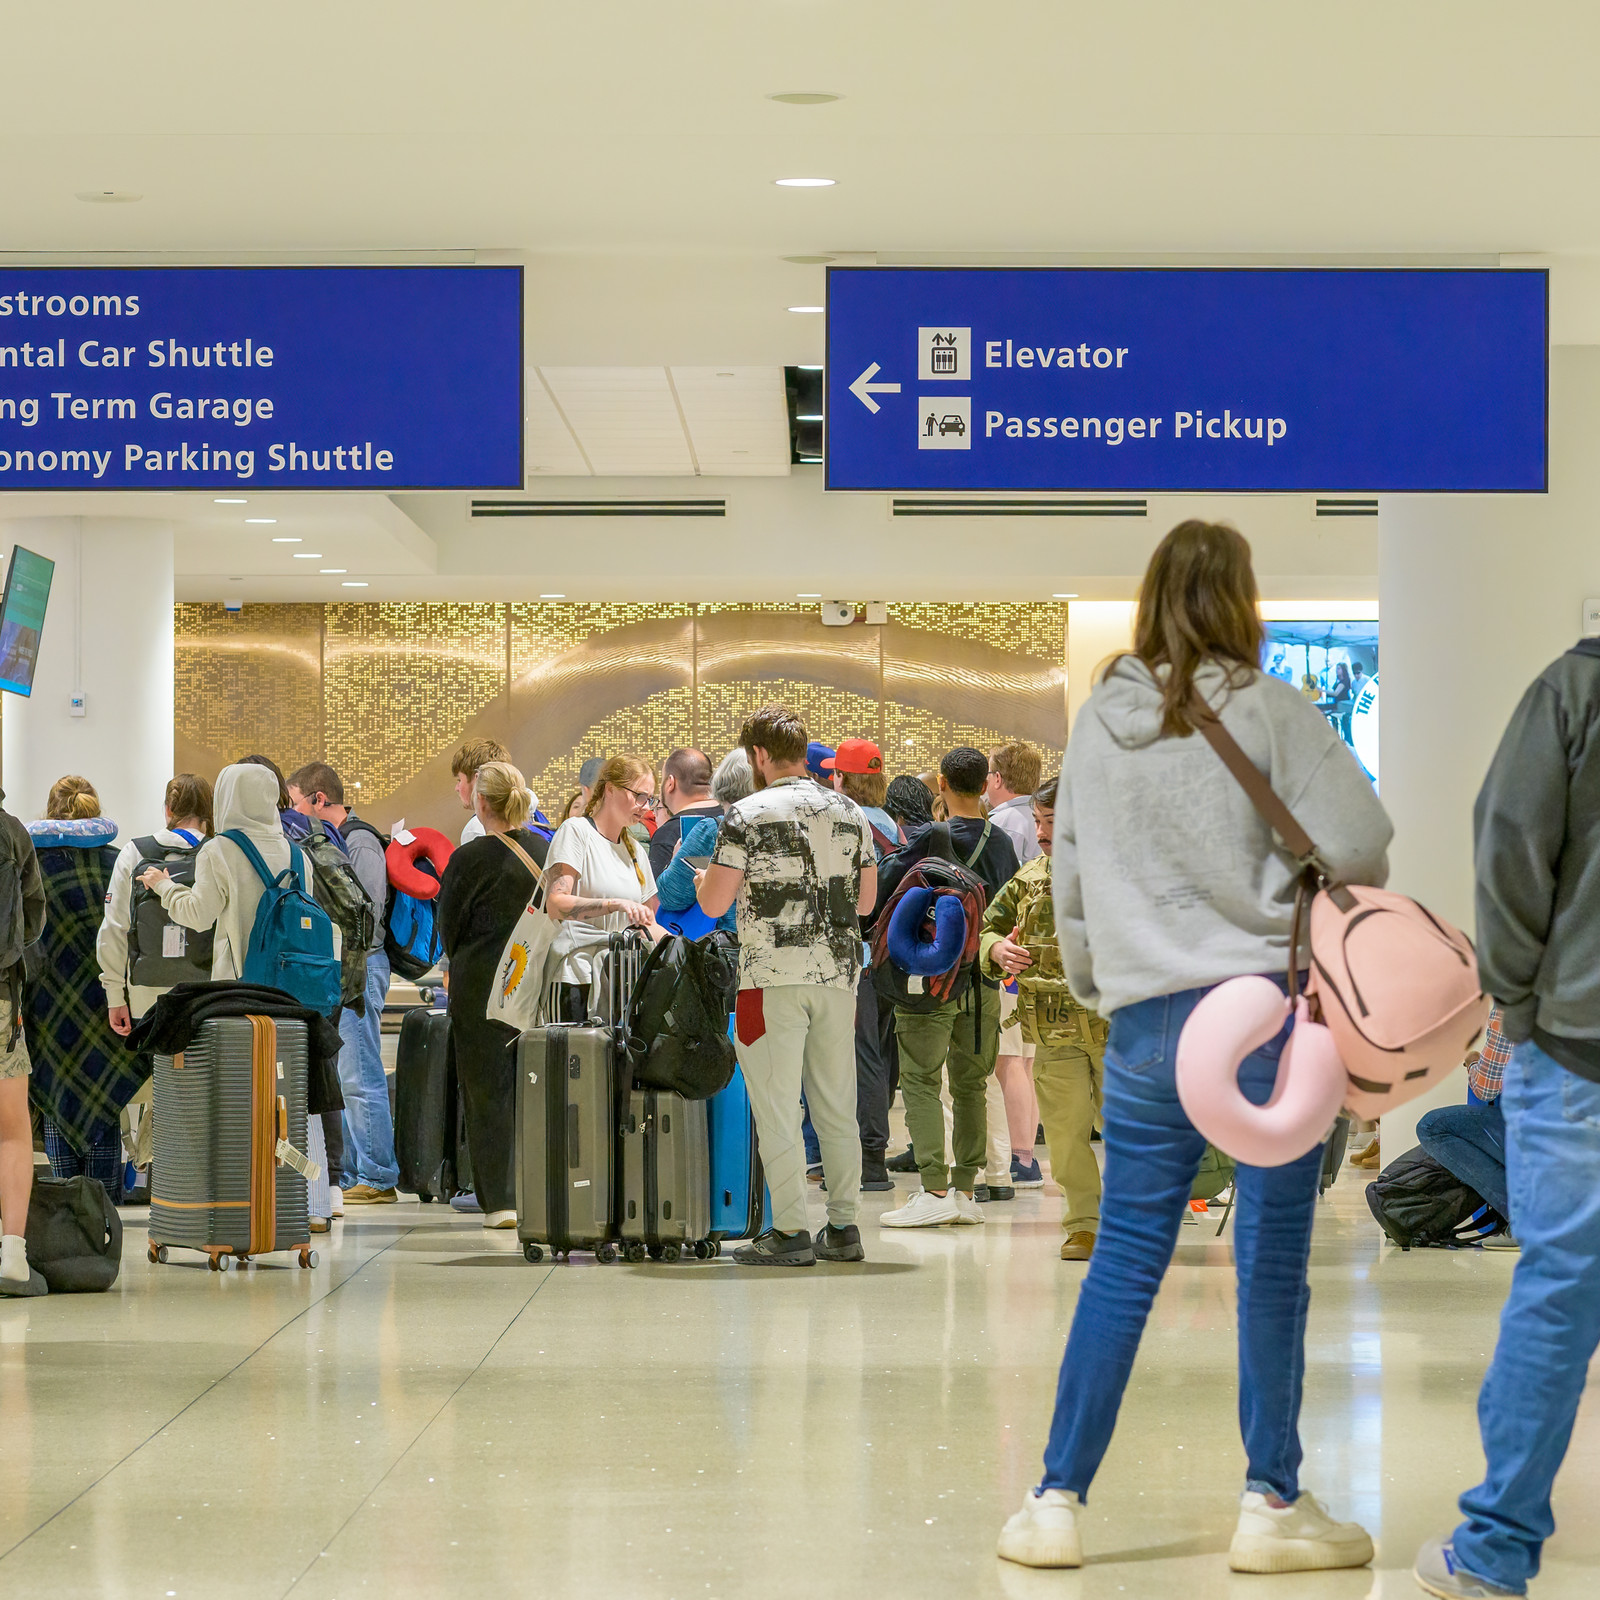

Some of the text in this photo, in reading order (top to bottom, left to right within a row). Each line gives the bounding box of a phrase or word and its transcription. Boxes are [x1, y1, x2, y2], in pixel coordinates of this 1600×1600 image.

[78, 341, 136, 368] Car
[148, 339, 274, 368] Shuttle
[985, 340, 1129, 369] Elevator
[51, 392, 136, 420] Term
[149, 393, 274, 426] Garage
[985, 409, 1287, 446] Passenger Pickup
[124, 442, 255, 479] Parking
[268, 441, 394, 471] Shuttle
[1356, 690, 1376, 714] THE
[1046, 1008, 1069, 1023] US
